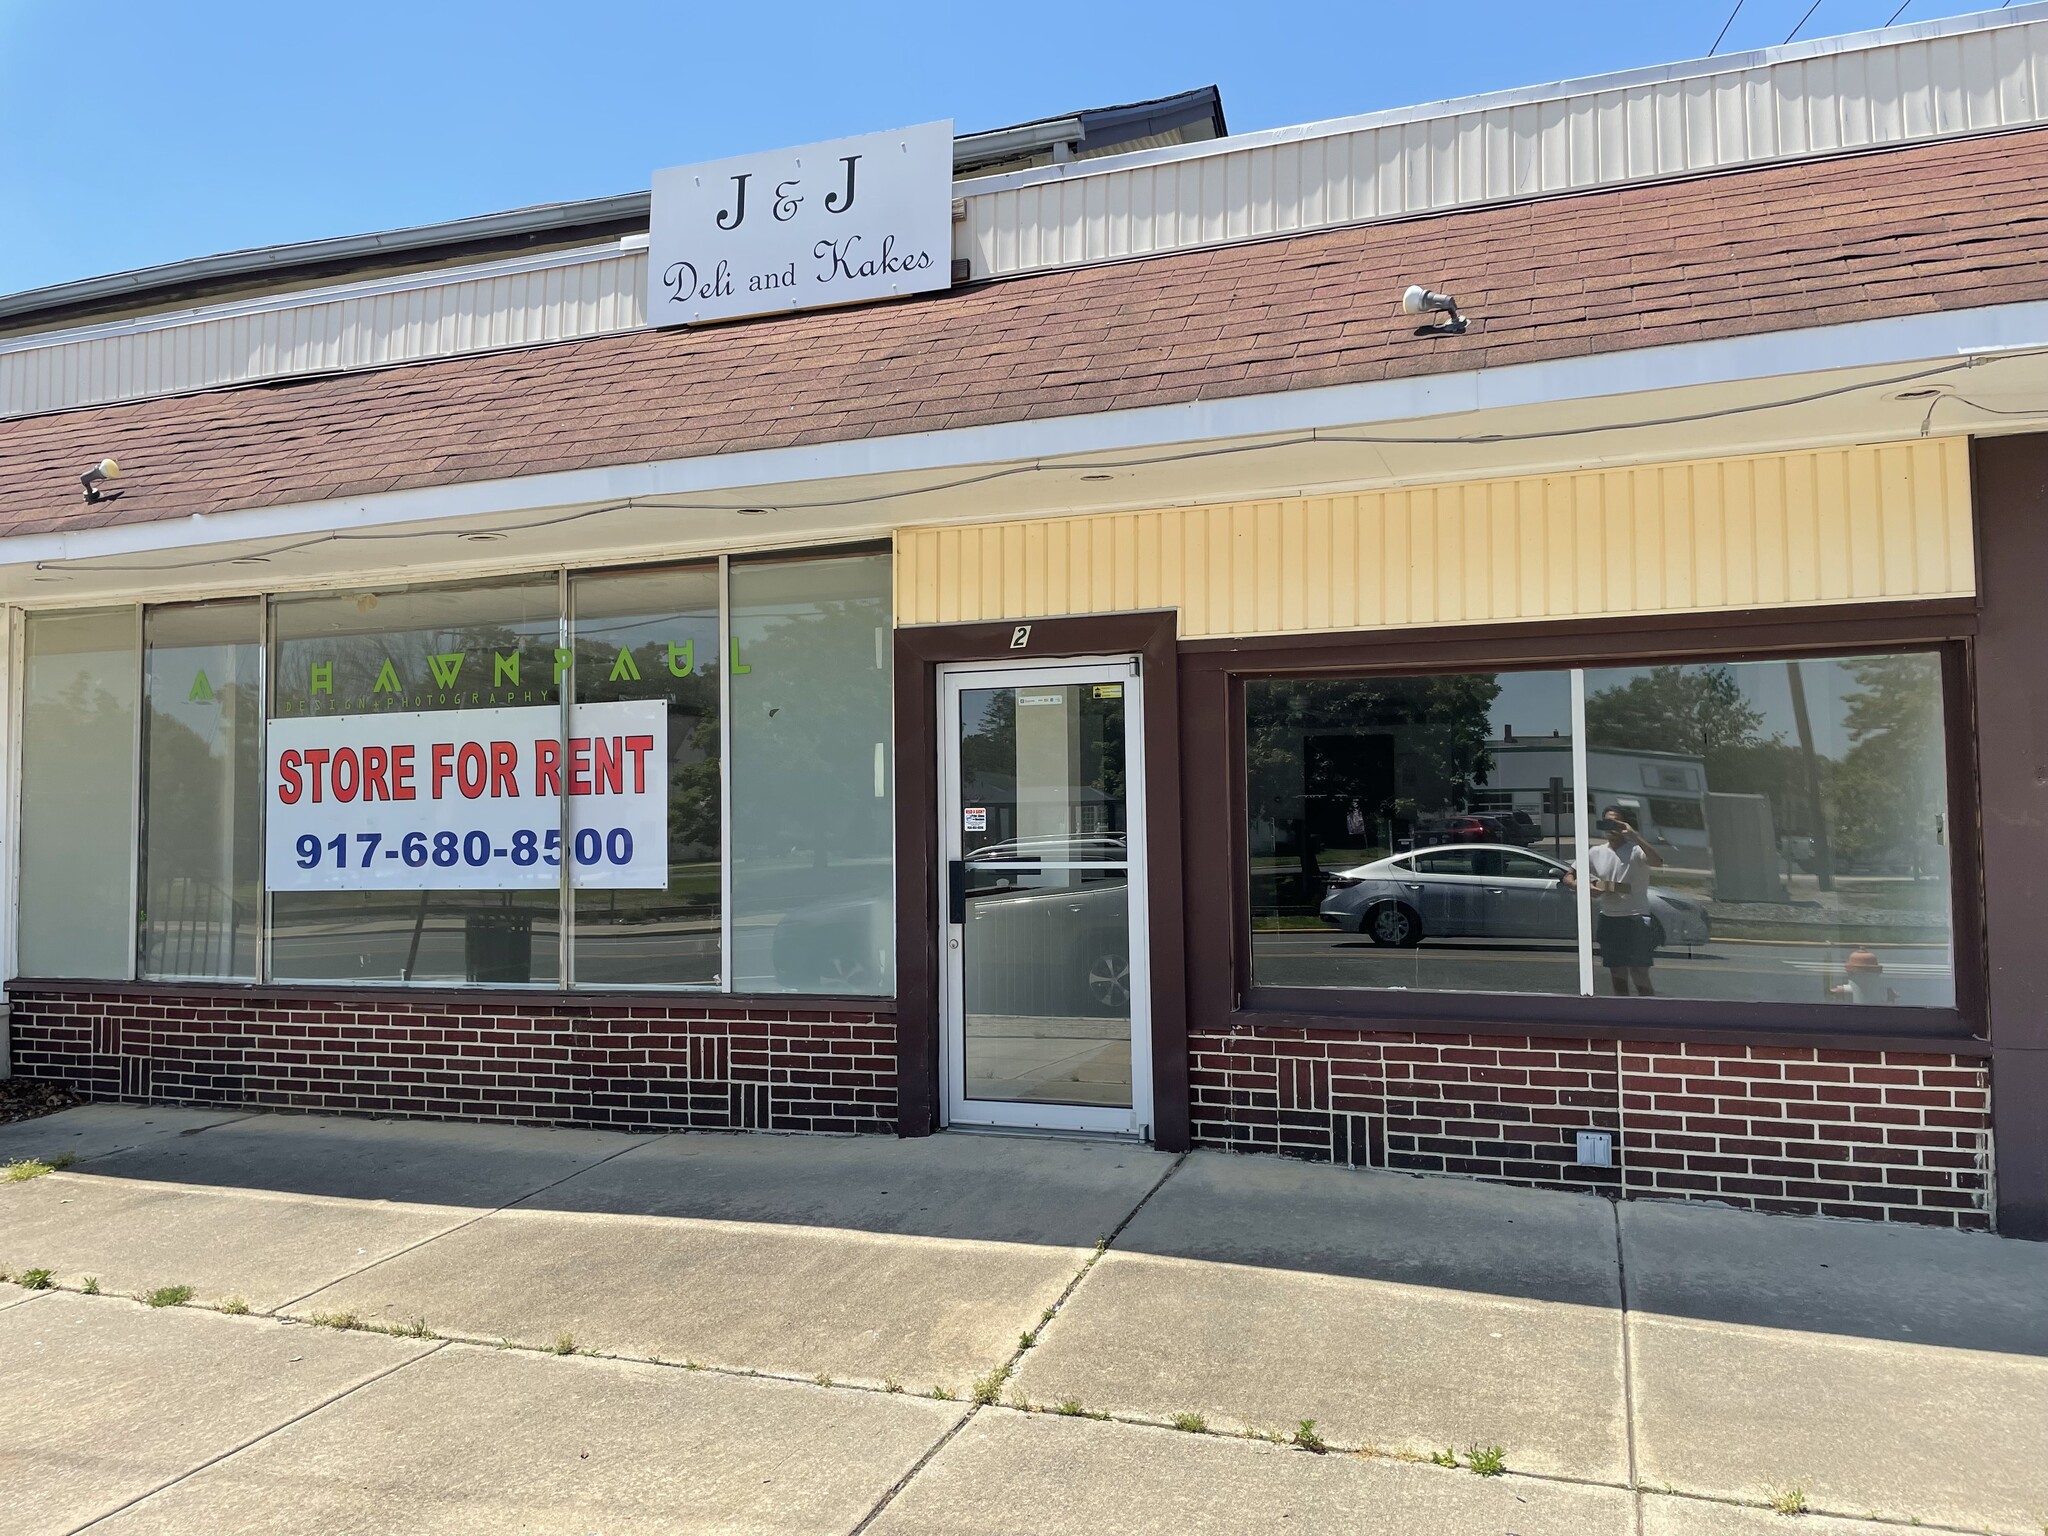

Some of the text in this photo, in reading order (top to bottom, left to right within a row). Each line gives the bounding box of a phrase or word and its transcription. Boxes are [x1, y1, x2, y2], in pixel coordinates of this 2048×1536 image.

[716, 154, 863, 231] J & J
[662, 234, 935, 304] Deli and Kakes
[1012, 627, 1028, 647] 2
[278, 735, 654, 805] STORE FOR RENT
[295, 827, 634, 869] 917-680-8500
